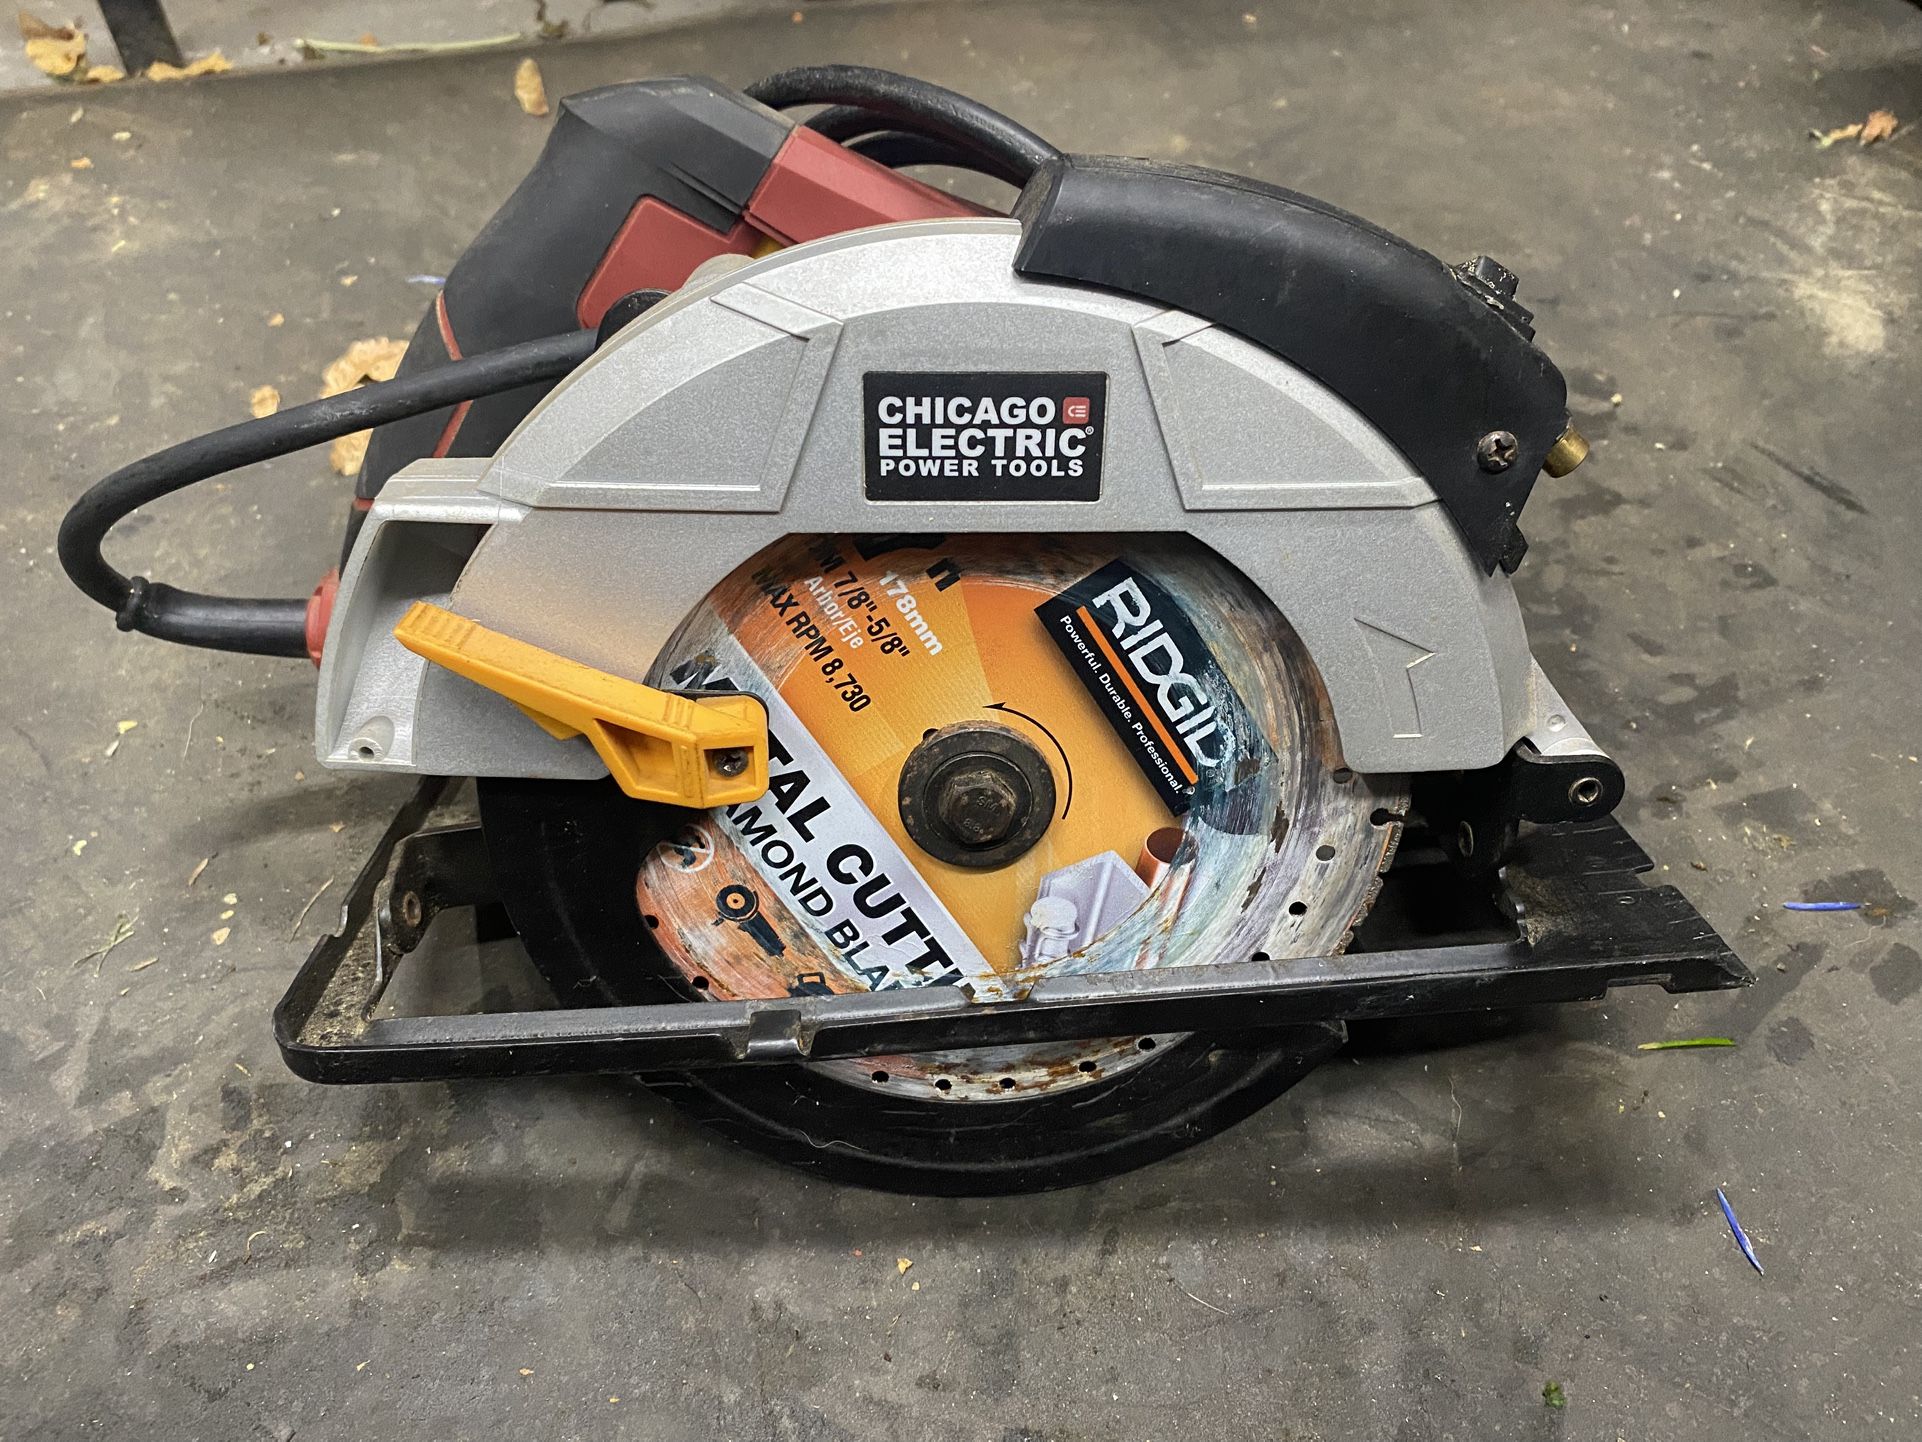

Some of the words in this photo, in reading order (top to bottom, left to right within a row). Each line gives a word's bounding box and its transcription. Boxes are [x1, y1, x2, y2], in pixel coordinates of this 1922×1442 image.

[878, 396, 1056, 425] CHICAGO
[880, 459, 979, 477] POWER
[991, 459, 1084, 477] TOOLS
[752, 565, 799, 617] MAX
[786, 611, 834, 662] RPM
[821, 658, 872, 713] 8,730
[804, 575, 864, 649] Arbor/Eje
[879, 570, 943, 656] 178mm
[1092, 576, 1236, 767] RIDGID
[824, 922, 904, 991] BLA
